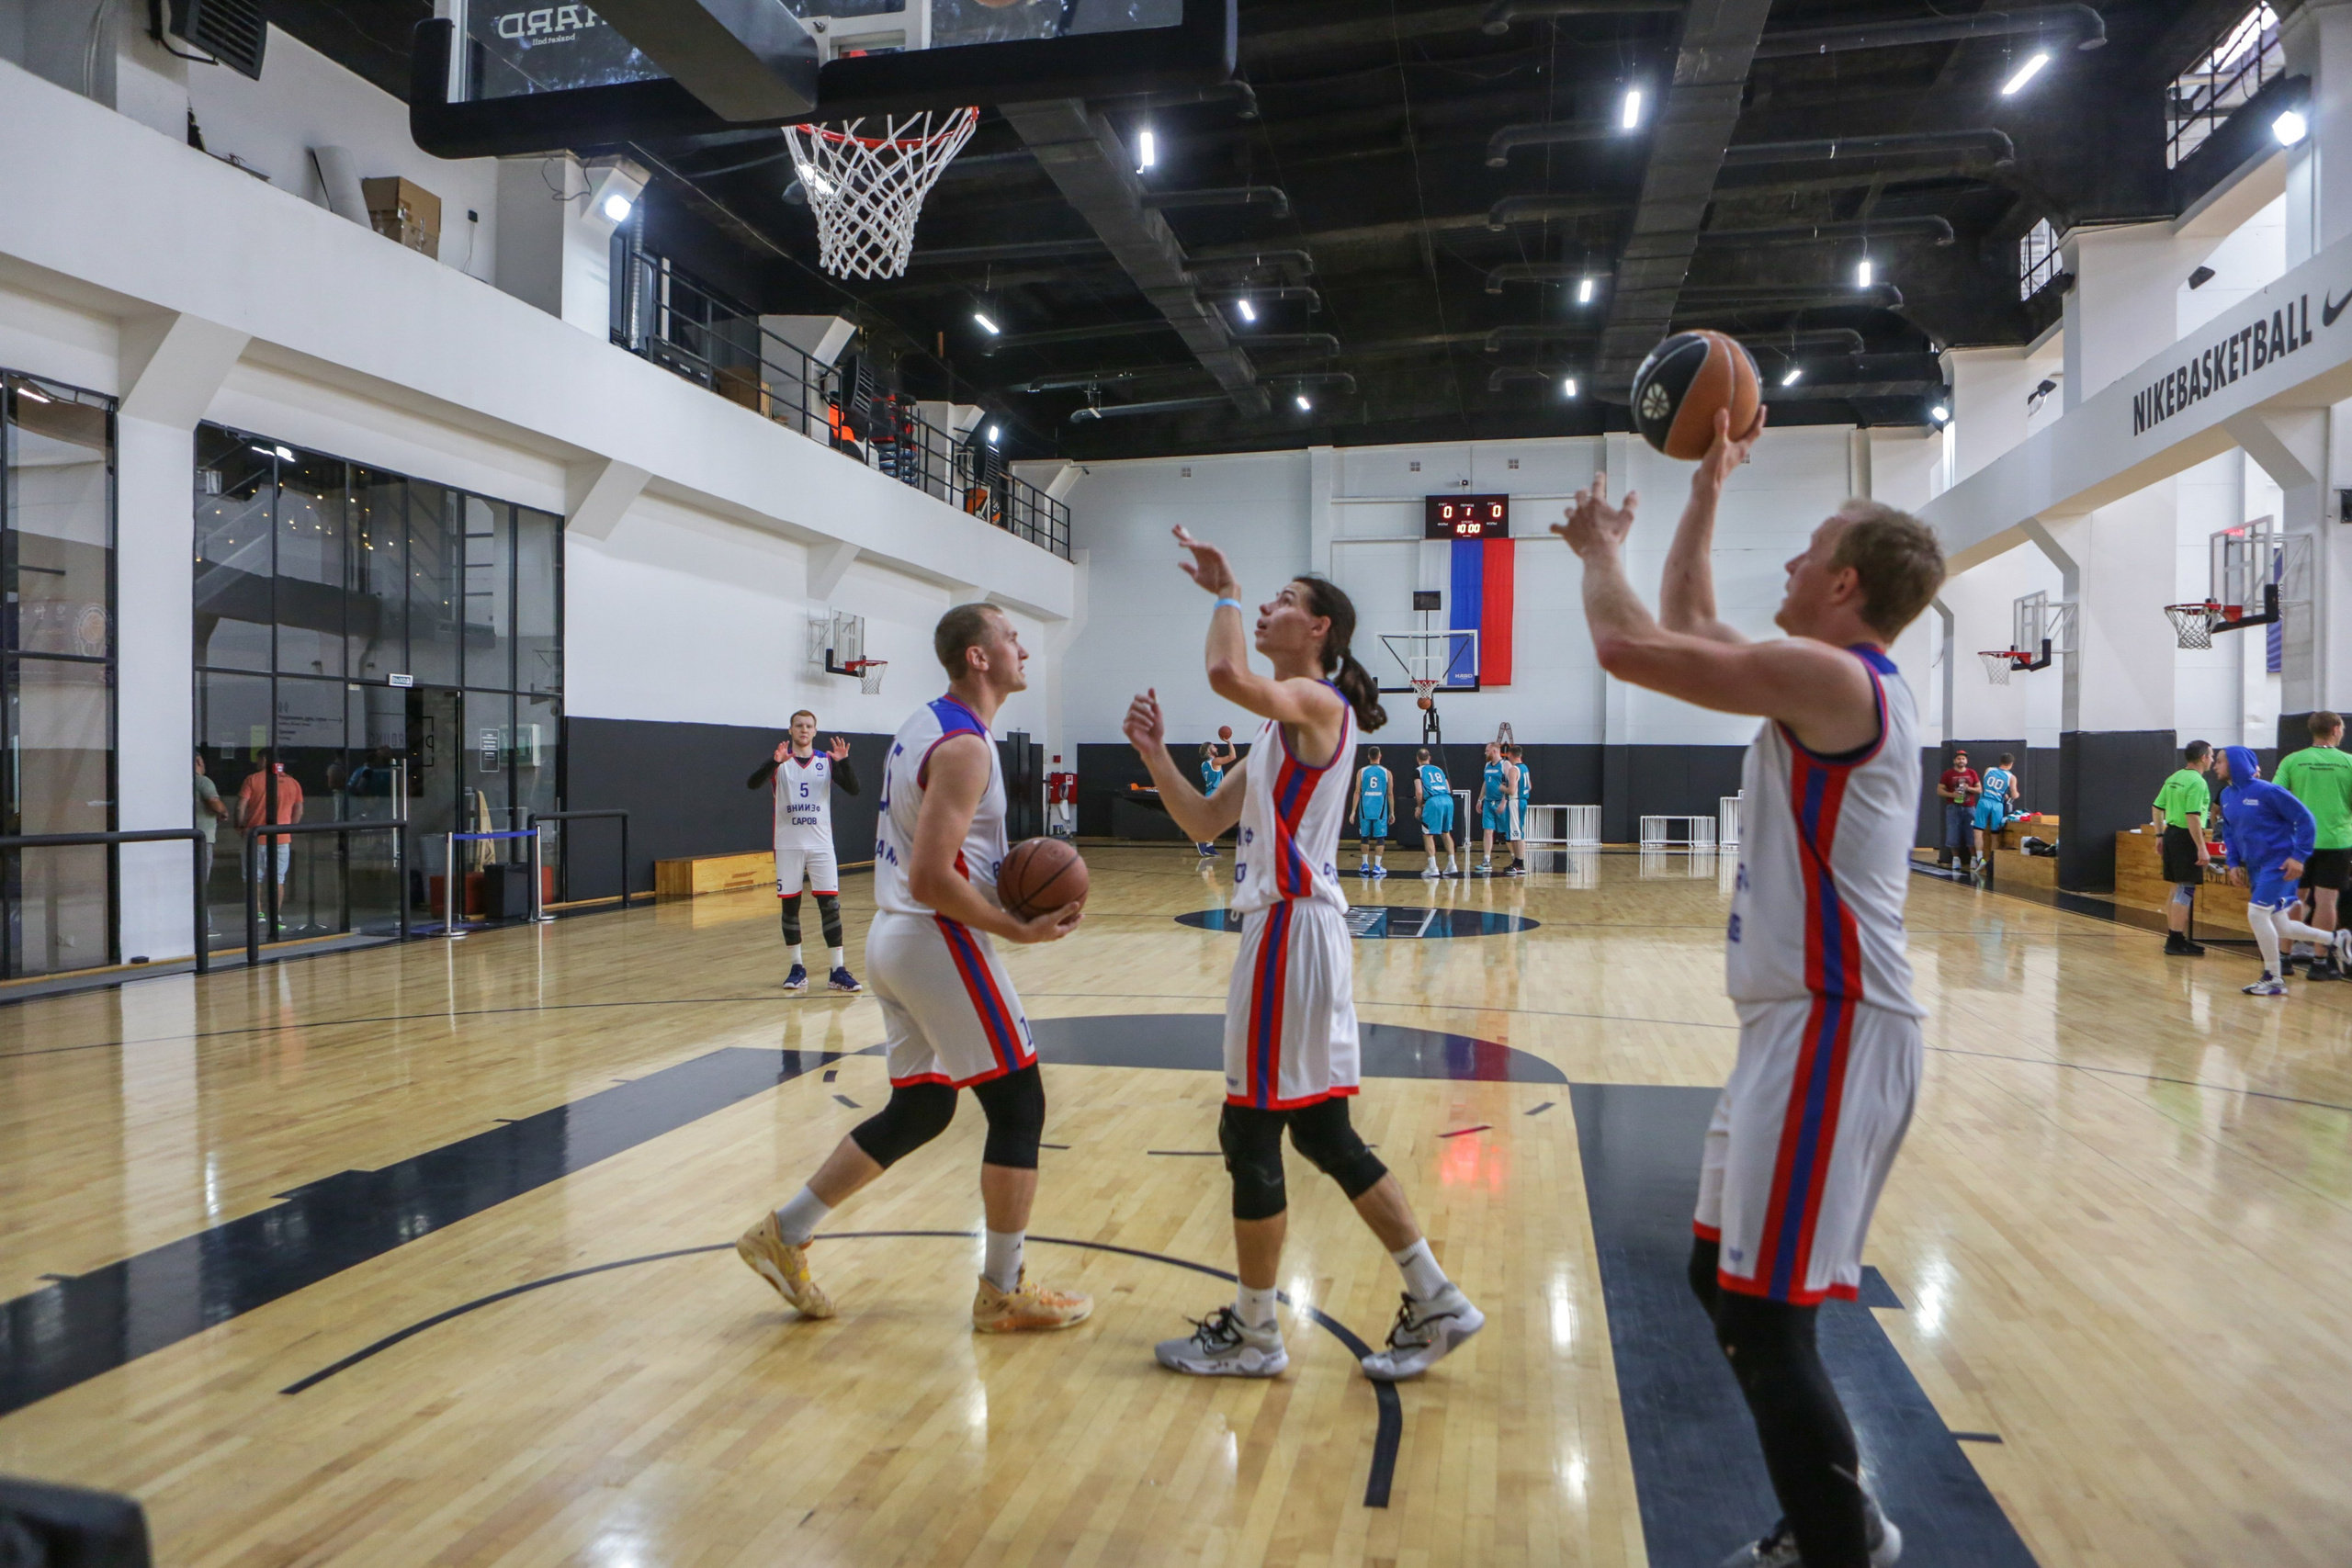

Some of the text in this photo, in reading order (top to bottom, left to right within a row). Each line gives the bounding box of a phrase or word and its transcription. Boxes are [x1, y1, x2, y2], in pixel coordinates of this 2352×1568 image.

[2132, 293, 2313, 436] NIKEBASKETBALL
[1443, 505, 1453, 518] 0
[1466, 507, 1471, 516] 1
[1492, 504, 1501, 517] 0
[1369, 776, 1378, 789] 6
[1428, 772, 1443, 784] 18
[1986, 775, 2005, 791] 00
[799, 782, 809, 798] 5
[791, 817, 818, 826] САРОВ
[776, 879, 783, 892] 5
